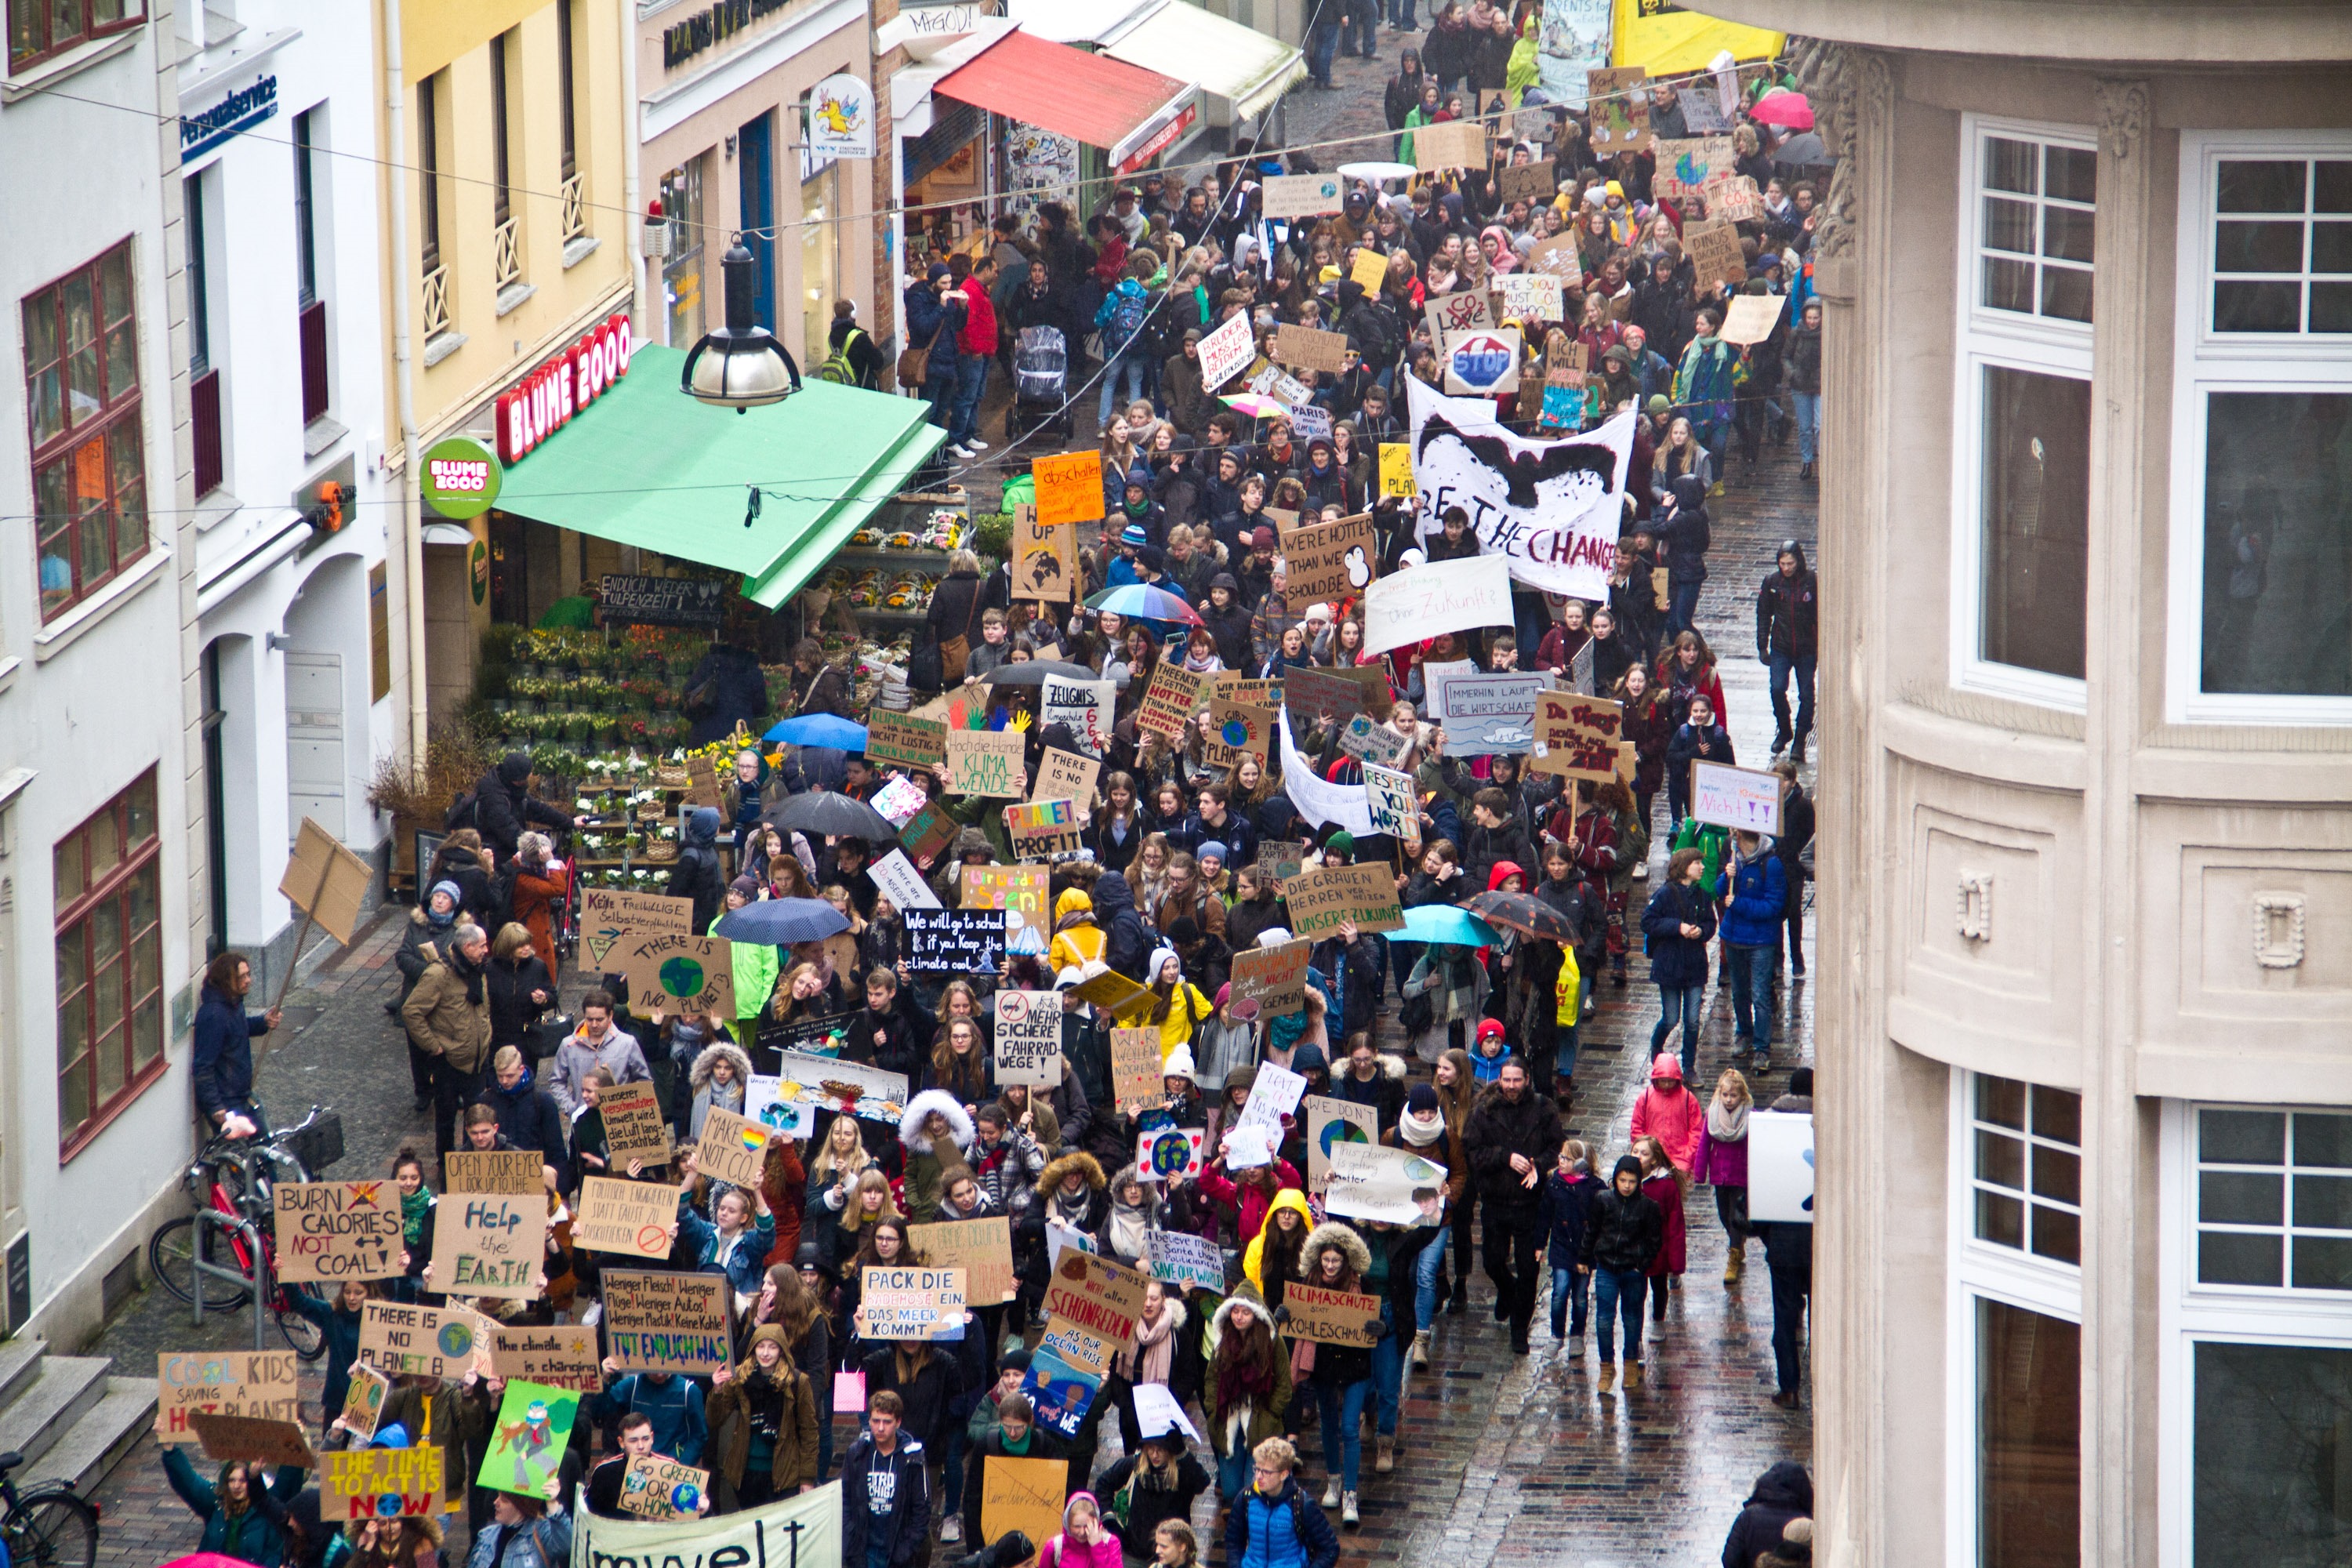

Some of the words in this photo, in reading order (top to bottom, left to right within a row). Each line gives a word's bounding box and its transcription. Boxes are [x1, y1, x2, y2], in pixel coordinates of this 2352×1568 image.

[180, 74, 277, 149] Personalservice
[1661, 143, 1681, 156] Die
[1704, 140, 1726, 153] Uhr
[1668, 179, 1704, 195] TICK
[1693, 230, 1729, 250] DINOS
[1497, 281, 1519, 290] THE
[1203, 320, 1242, 354] BRUDER
[1206, 340, 1230, 363] MUSS
[1233, 326, 1250, 346] LOS
[1454, 348, 1511, 372] STOP
[1556, 343, 1577, 356] ICH
[1551, 358, 1579, 369] WILL
[509, 359, 572, 462] BLUME
[578, 319, 630, 406] 2000
[1292, 406, 1326, 419] PARIS
[430, 459, 488, 477] BLUME
[1039, 462, 1054, 471] Mit
[1044, 463, 1102, 484] abschalten
[435, 475, 485, 491] 2000
[1032, 525, 1054, 540] UP
[1289, 557, 1319, 575] THAN
[1323, 550, 1343, 566] WE
[601, 575, 648, 593] ENDLICH
[1288, 579, 1327, 601] SHOULD
[1328, 573, 1345, 593] BE
[1048, 684, 1095, 704] ZEUGNIS
[1217, 683, 1234, 691] WIR
[1237, 681, 1265, 691] HABEN
[1269, 681, 1284, 689] NUR
[1449, 685, 1494, 699] IMMERHIN
[1501, 685, 1540, 695] LÄUFT
[871, 708, 945, 735] KLIMAWANDEL
[1211, 716, 1225, 731] ES
[1225, 710, 1248, 722] GIBT
[1245, 721, 1258, 740] KEIN
[867, 742, 897, 758] FINDEN
[898, 749, 916, 761] WIR
[916, 752, 941, 764] AUCH!
[964, 753, 1007, 774] KLIMA
[1567, 747, 1618, 771] ZEIT
[955, 771, 1013, 795] WENDE
[1365, 769, 1412, 794] RESPECT
[1381, 791, 1417, 815] YOUR
[1007, 800, 1073, 829] PLANET
[902, 810, 935, 850] NATURE
[1026, 827, 1060, 837] before
[1014, 831, 1080, 855] PROFIT
[1258, 859, 1269, 868] IS
[892, 862, 913, 887] there
[909, 885, 921, 900] are
[1288, 878, 1310, 895] DIE
[1313, 871, 1371, 887] GRAUEN
[599, 911, 687, 934] Selbstverpflichtung
[905, 912, 927, 930] We
[929, 913, 949, 930] will
[950, 917, 962, 936] go
[963, 911, 973, 930] to
[976, 913, 1004, 931] school
[633, 935, 688, 960] THERE
[695, 938, 714, 956] IS
[927, 934, 937, 950] if
[939, 939, 955, 954] you
[985, 936, 1003, 952] the
[904, 956, 949, 970] climate
[1264, 970, 1295, 985] NICHT
[1244, 985, 1276, 998] euer
[1262, 988, 1306, 1010] GEMEINT
[1027, 1011, 1062, 1024] MEHR
[996, 1023, 1055, 1038] SICHERE
[1004, 1040, 1062, 1056] FAHRRAD-
[607, 1089, 638, 1102] unserer
[604, 1112, 635, 1125] Umwelt
[637, 1109, 655, 1120] wird
[1308, 1097, 1332, 1113] WE
[1338, 1100, 1375, 1119] DON'T
[608, 1127, 622, 1140] die
[623, 1123, 640, 1137] Luft
[641, 1123, 662, 1138] lang-
[706, 1114, 743, 1148] MAKE
[448, 1153, 481, 1177] OPEN
[485, 1153, 515, 1175] YOUR
[516, 1153, 543, 1178] EYES
[1331, 1173, 1368, 1185] hotter
[278, 1188, 342, 1213] BURN
[301, 1210, 400, 1236] CALORIES
[465, 1200, 522, 1235] Help
[292, 1234, 335, 1255] NOT
[481, 1236, 510, 1254] the
[1147, 1232, 1153, 1242] I
[1154, 1234, 1190, 1249] believe
[1192, 1239, 1218, 1253] more
[315, 1249, 389, 1276] COAL!
[867, 1272, 916, 1290] PACK
[921, 1271, 954, 1289] DIE
[1151, 1260, 1177, 1279] SAVE
[1178, 1265, 1195, 1281] OUR
[1196, 1266, 1224, 1288] WORLD
[604, 1275, 642, 1296] Weniger
[642, 1276, 676, 1293] Fleisch!
[678, 1278, 716, 1298] Weniger
[1288, 1283, 1377, 1312] KLIMASCHUTZ
[366, 1305, 417, 1326] THERE
[422, 1312, 438, 1329] IS
[607, 1311, 645, 1328] Weniger
[645, 1312, 675, 1328] Plastik!
[675, 1314, 702, 1331] Keine
[702, 1315, 726, 1332] Kohle!
[867, 1309, 893, 1321] DAS
[897, 1308, 939, 1322] MEER
[1049, 1287, 1135, 1341] SCHÖNREDEN
[387, 1332, 412, 1347] NO
[870, 1323, 928, 1337] KOMMT
[1064, 1328, 1082, 1342] AS
[1083, 1335, 1102, 1350] OUR
[612, 1332, 639, 1359] TUT
[641, 1332, 695, 1366] ENDLICH
[695, 1335, 728, 1364] WAS
[1044, 1332, 1080, 1357] OCEAN
[1080, 1347, 1103, 1367] RISE
[246, 1356, 296, 1385] KIDS
[361, 1349, 429, 1372] PLANET
[431, 1358, 445, 1376] B
[176, 1387, 221, 1403] SAVING
[238, 1385, 246, 1399] A
[1059, 1412, 1083, 1435] WE
[328, 1452, 377, 1475] THE
[382, 1448, 441, 1472] TIME
[633, 1457, 654, 1477] Go
[659, 1462, 702, 1485] GREEN
[328, 1475, 363, 1496] TO
[369, 1474, 415, 1494] ACT
[419, 1473, 441, 1493] IS
[647, 1479, 670, 1498] OR
[620, 1495, 642, 1513] Go
[643, 1497, 677, 1520] HOME
